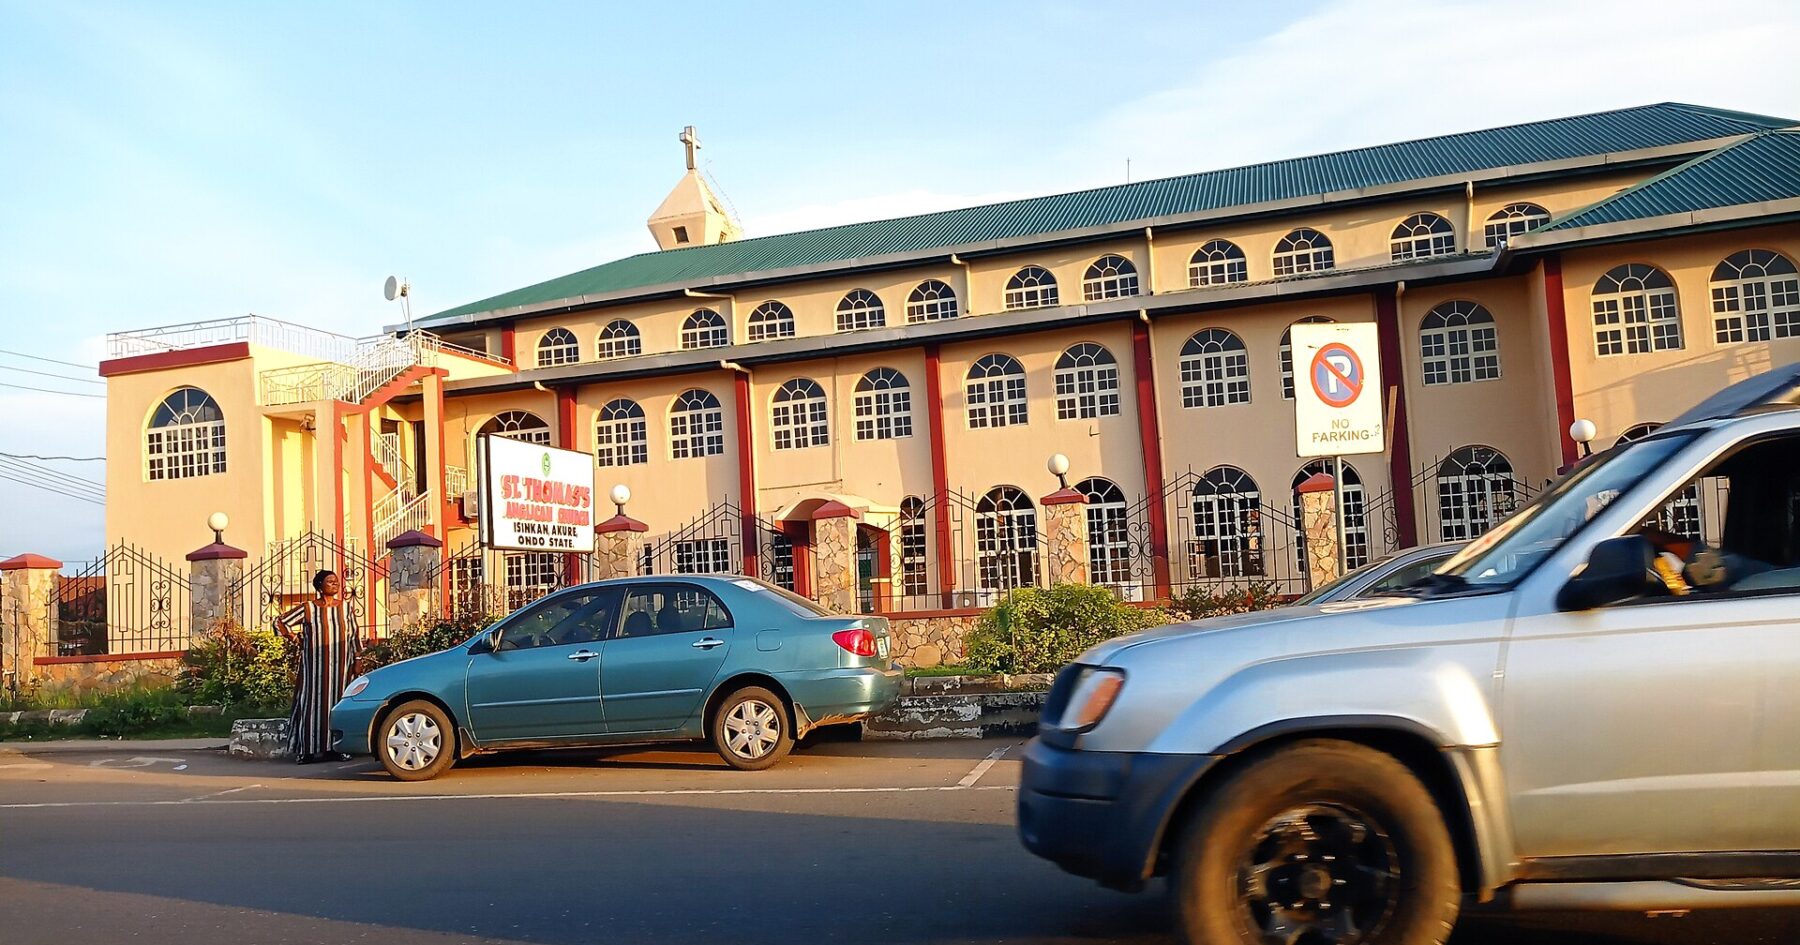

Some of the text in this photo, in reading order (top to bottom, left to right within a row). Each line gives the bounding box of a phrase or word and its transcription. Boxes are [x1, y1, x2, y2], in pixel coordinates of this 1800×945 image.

[1331, 419, 1350, 429] NO
[501, 475, 521, 499] ST.
[504, 501, 553, 522] ANGLICAN
[518, 535, 545, 547] ONDO
